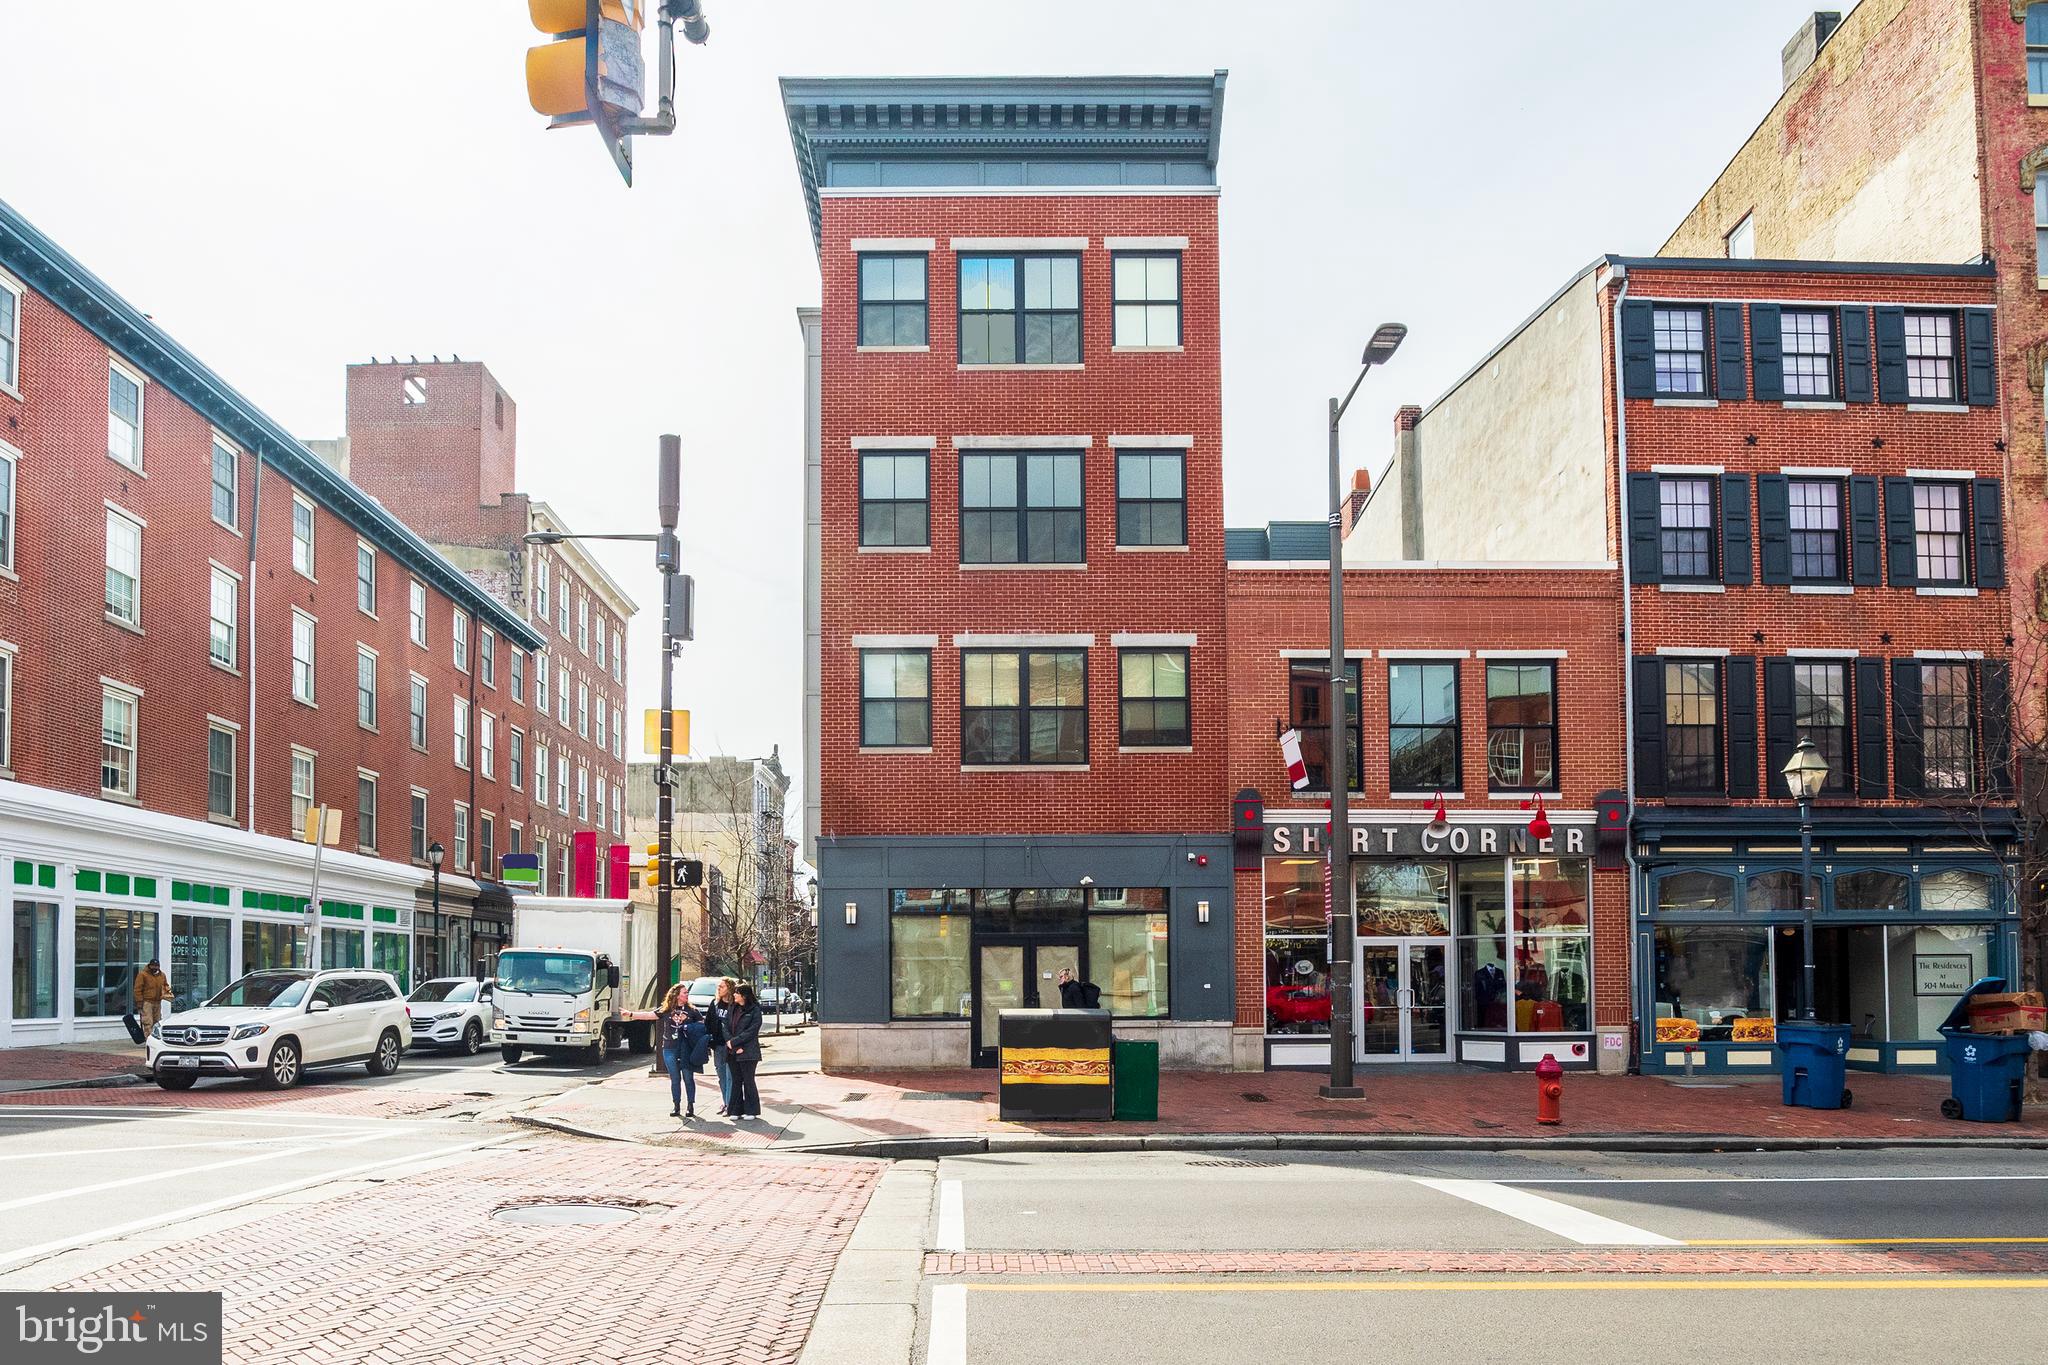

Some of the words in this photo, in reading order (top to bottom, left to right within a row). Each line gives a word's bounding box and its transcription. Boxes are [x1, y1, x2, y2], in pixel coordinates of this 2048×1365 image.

[1272, 827, 1398, 853] SHRT
[1421, 827, 1584, 853] CORNER
[1604, 1037, 1622, 1047] FDC
